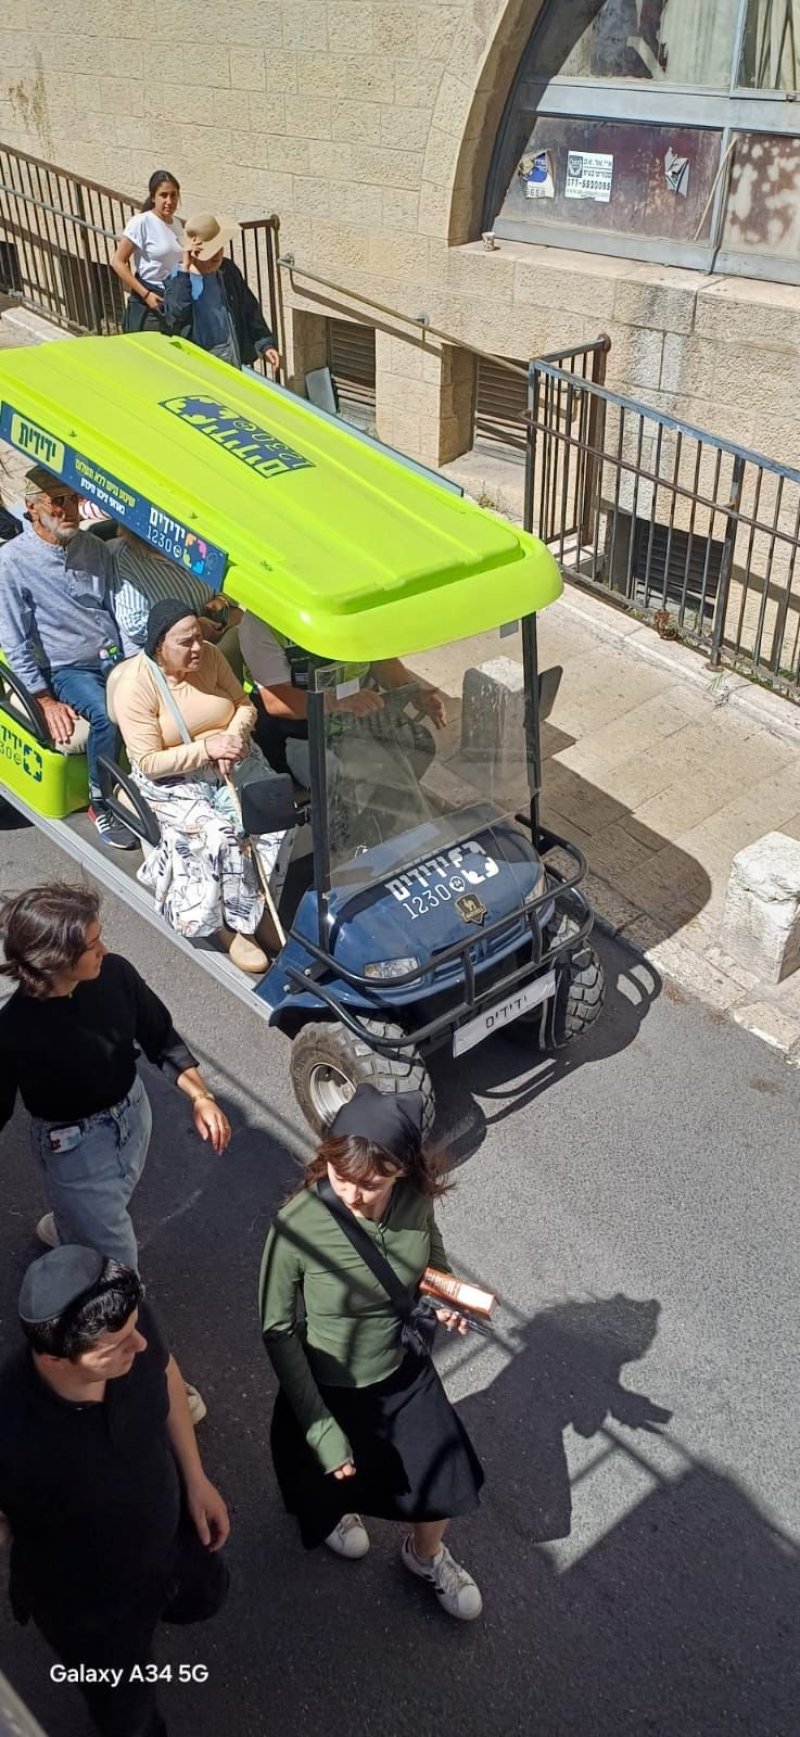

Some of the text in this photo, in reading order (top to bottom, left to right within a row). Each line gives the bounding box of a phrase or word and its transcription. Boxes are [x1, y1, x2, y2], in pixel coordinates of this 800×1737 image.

[18, 421, 57, 462] ידידית
[202, 425, 290, 478] ידידים
[94, 472, 106, 488] ללא
[146, 524, 172, 553] 1230
[149, 507, 186, 542] ידידים
[1, 724, 22, 750] ידיד
[384, 856, 450, 901] ידידים
[402, 884, 452, 919] 1230
[485, 995, 527, 1029] ידידים
